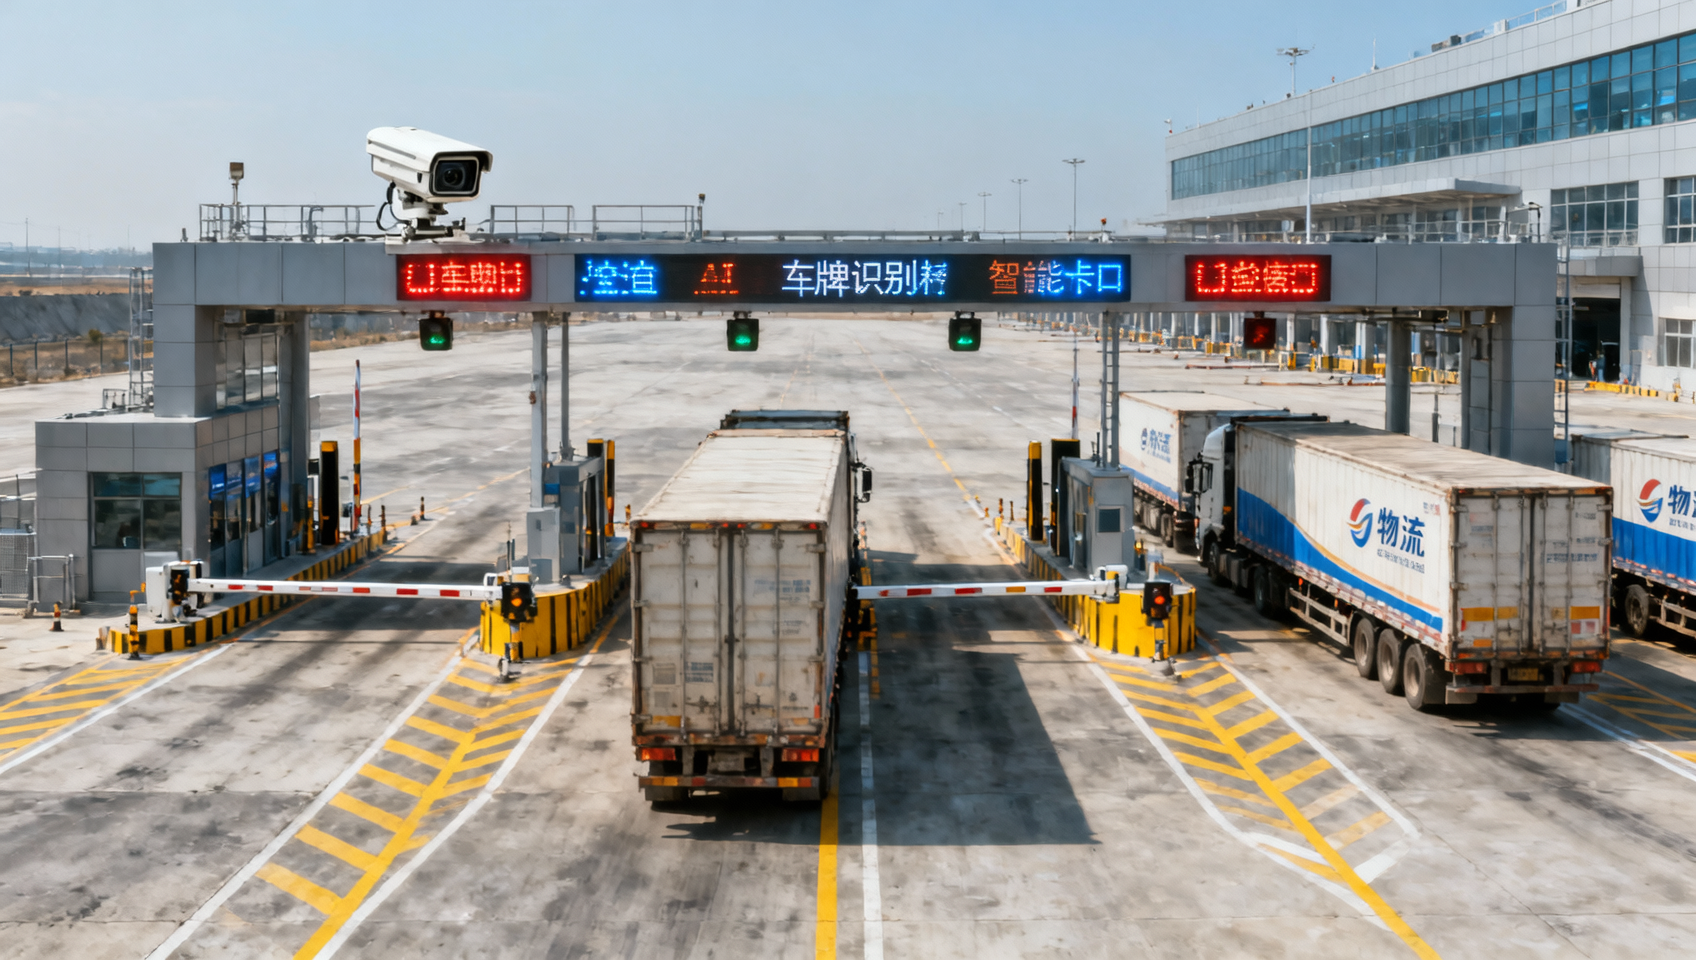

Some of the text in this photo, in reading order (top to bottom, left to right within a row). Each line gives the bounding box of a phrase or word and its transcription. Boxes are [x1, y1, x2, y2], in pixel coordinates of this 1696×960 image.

[988, 259, 1123, 296] 智能卡口
[1667, 484, 1696, 518] 物
[1377, 507, 1426, 558] 物流
